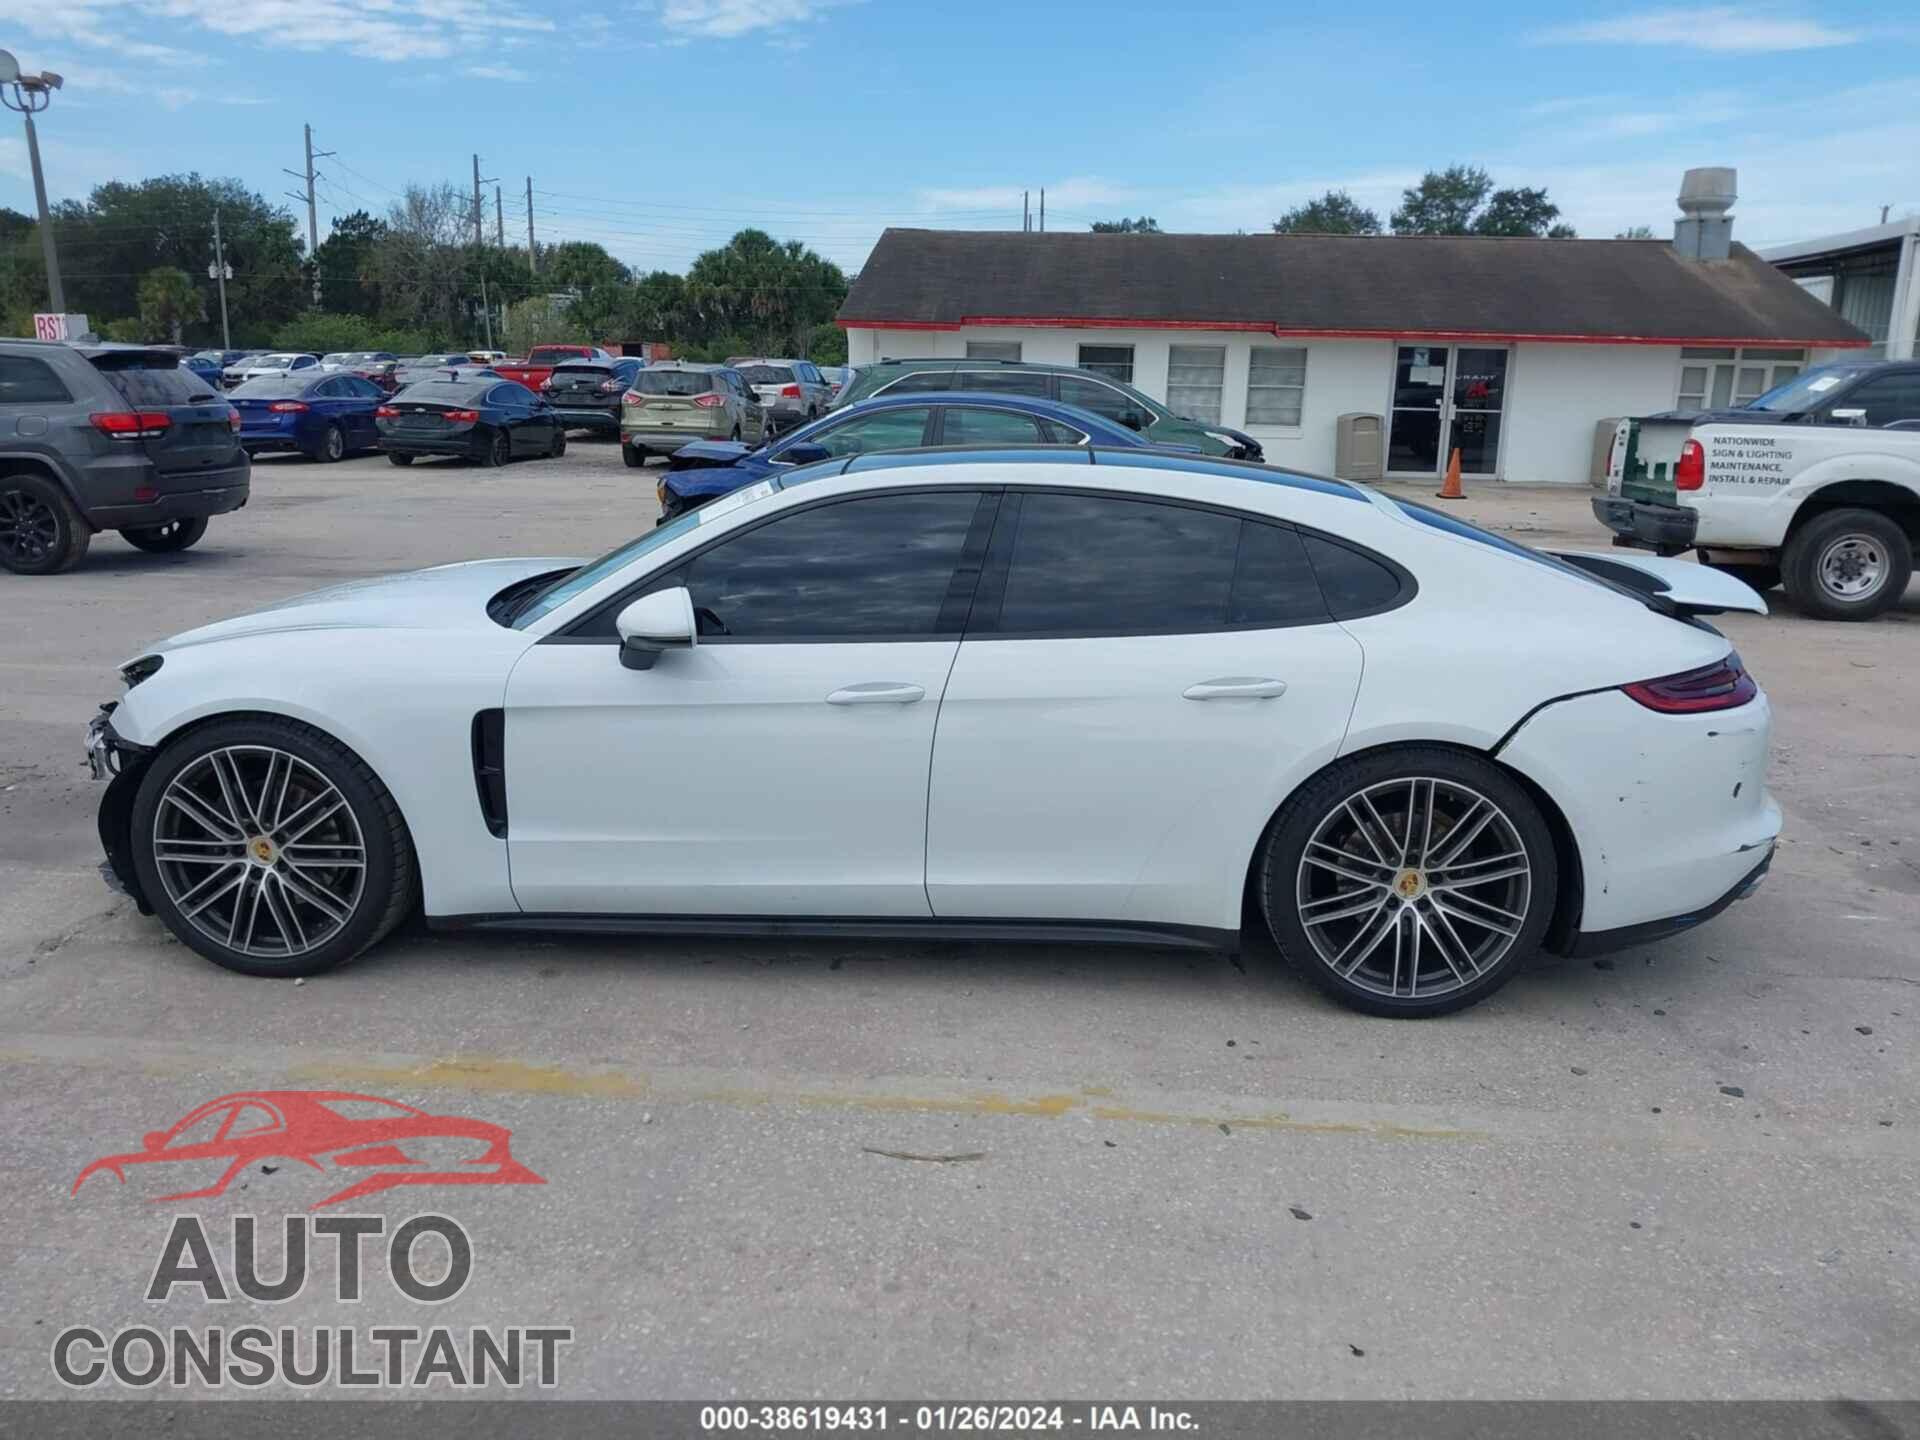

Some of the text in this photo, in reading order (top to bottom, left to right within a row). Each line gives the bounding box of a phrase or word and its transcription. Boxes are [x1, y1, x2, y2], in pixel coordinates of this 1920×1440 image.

[1713, 436, 1775, 447] NATIONWIDE
[1711, 449, 1793, 460] SIGN & LIGHTING
[1710, 462, 1783, 473] MAINTENANCE,
[1708, 475, 1792, 486] INSTALL & REPAIR
